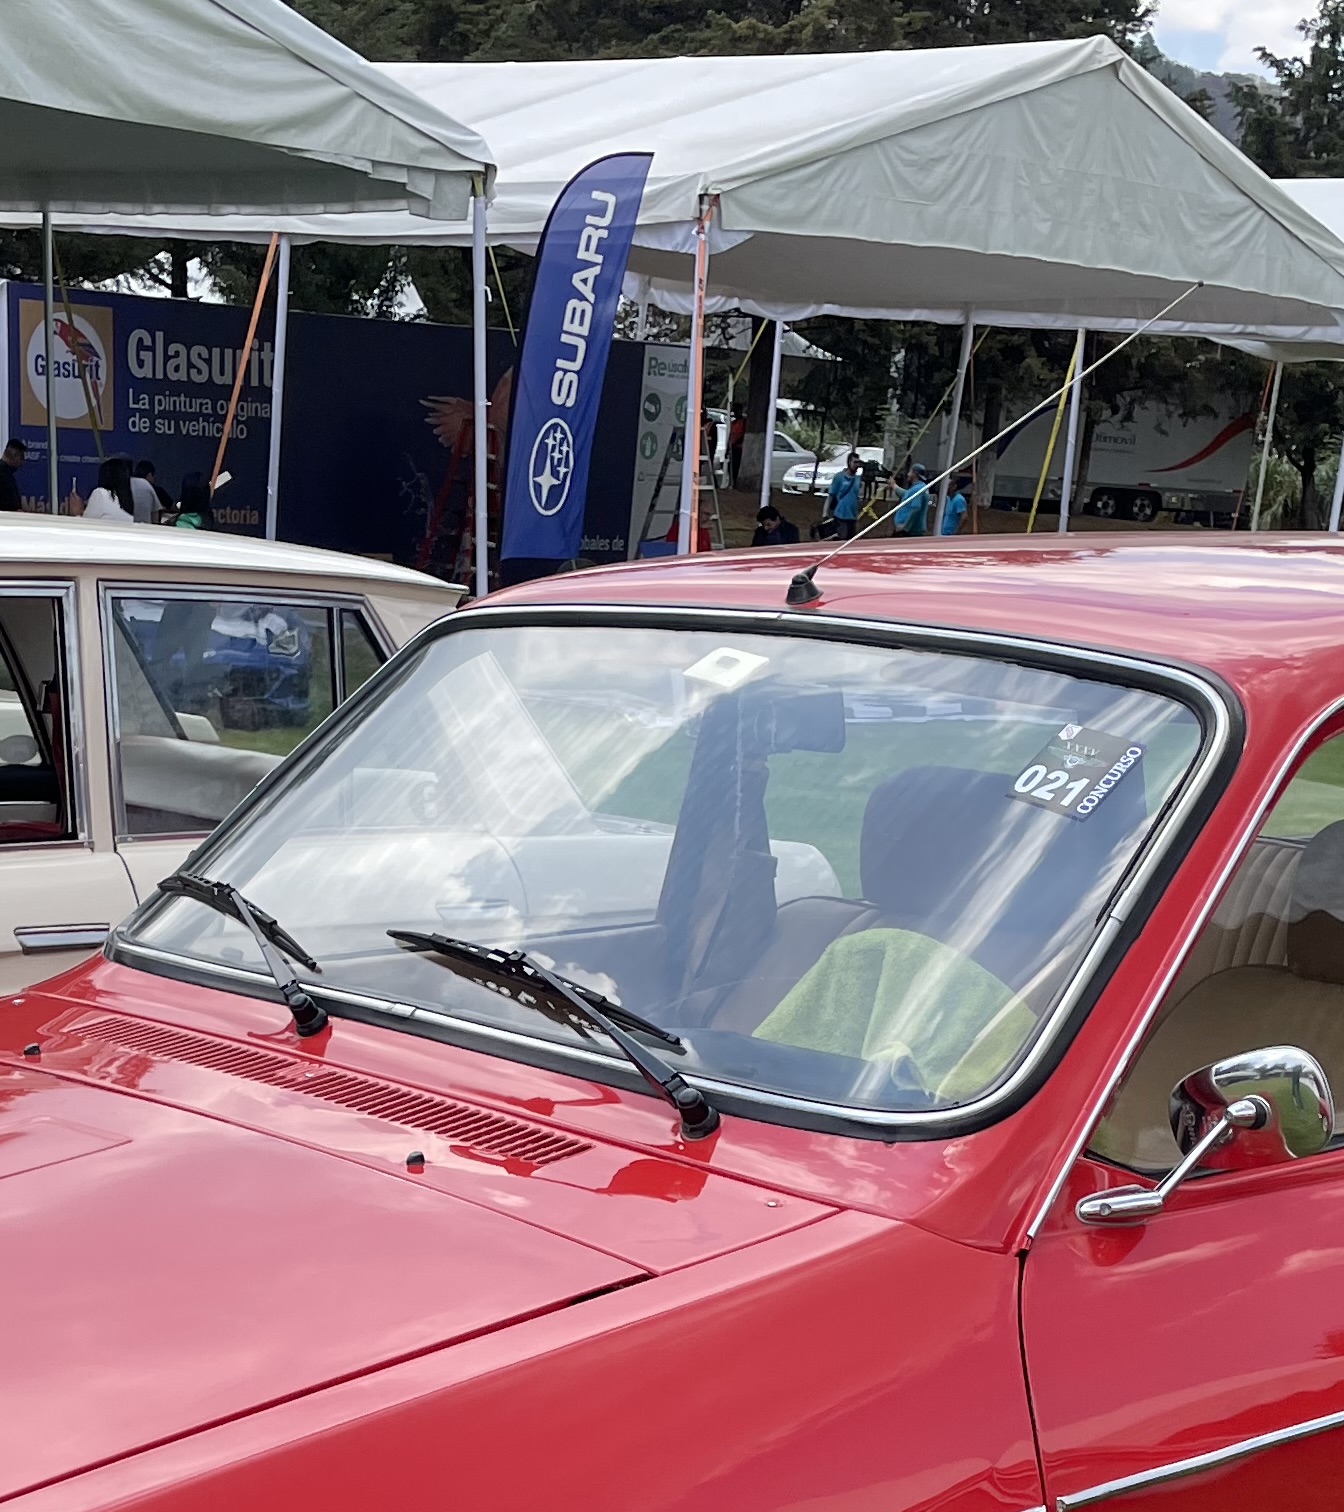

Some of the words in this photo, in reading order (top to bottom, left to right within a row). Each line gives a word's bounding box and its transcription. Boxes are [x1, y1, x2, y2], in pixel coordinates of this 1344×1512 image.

[551, 190, 616, 408] SUBARU
[129, 388, 150, 409] La
[155, 391, 212, 414] pintura
[217, 397, 271, 420] ogina
[128, 412, 150, 433] de
[155, 418, 175, 435] su
[179, 415, 247, 439] vehíclo
[612, 534, 625, 551] de
[1014, 764, 1091, 807] 021
[1076, 746, 1142, 814] CONCURSO
